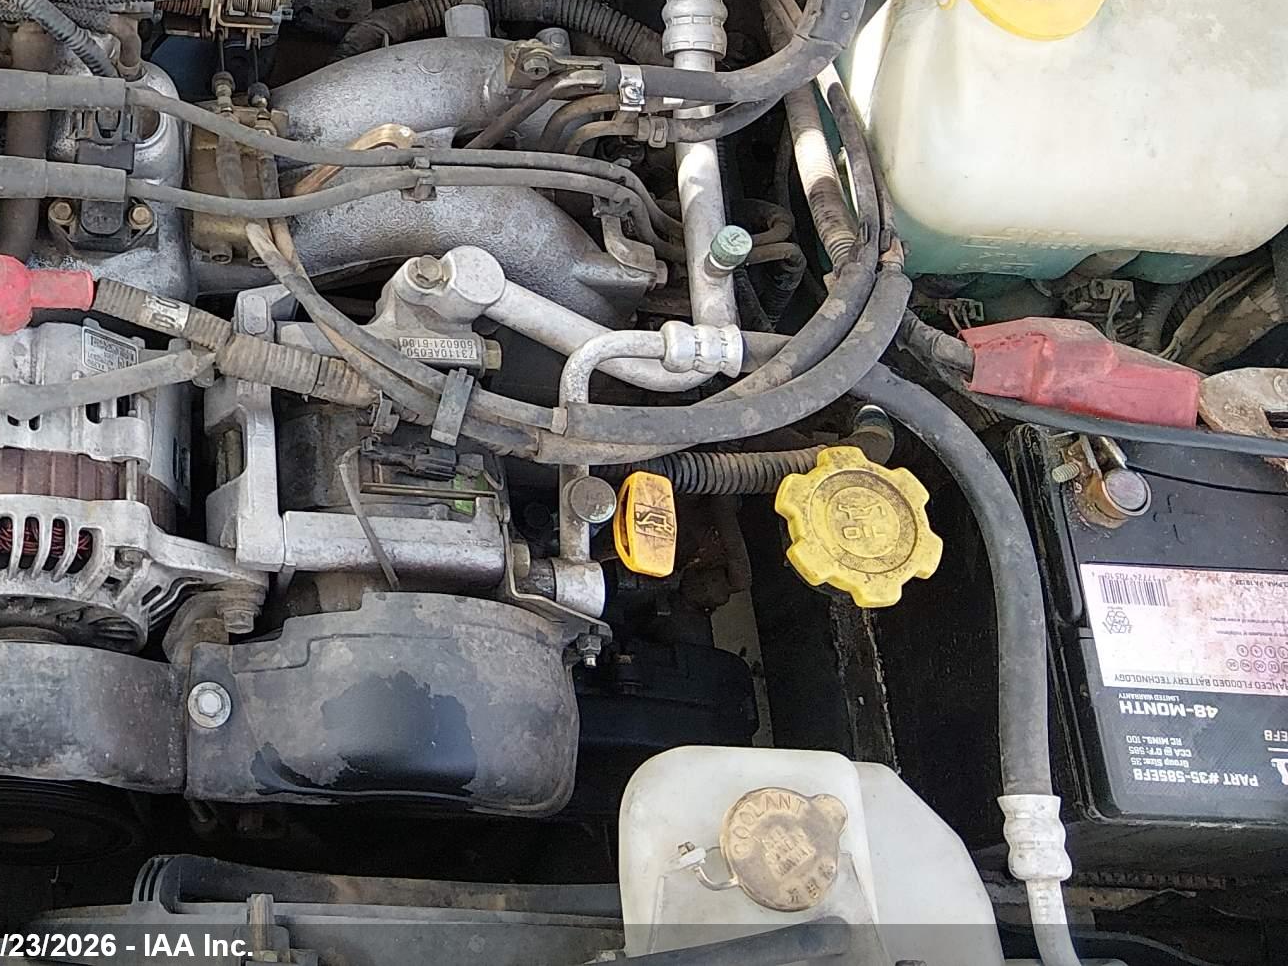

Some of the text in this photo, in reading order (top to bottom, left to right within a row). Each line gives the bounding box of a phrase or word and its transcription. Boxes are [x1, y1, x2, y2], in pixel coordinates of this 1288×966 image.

[406, 348, 475, 359] 73110AE050
[842, 525, 886, 540] OIL
[1114, 673, 1172, 685] TECHNOLOGY
[1173, 676, 1211, 687] BATTERY
[1213, 678, 1253, 689] FLOODED
[1119, 700, 1219, 719] 48-MONTH
[1126, 735, 1142, 744] 100
[1170, 737, 1183, 746] RC
[1128, 745, 1146, 755] 585
[1163, 747, 1173, 756] @
[1175, 748, 1192, 757] CCA
[1130, 756, 1190, 768] Group Size: 35
[1133, 768, 1260, 787] PART #35-585EFB
[732, 793, 807, 857] COOLANT
